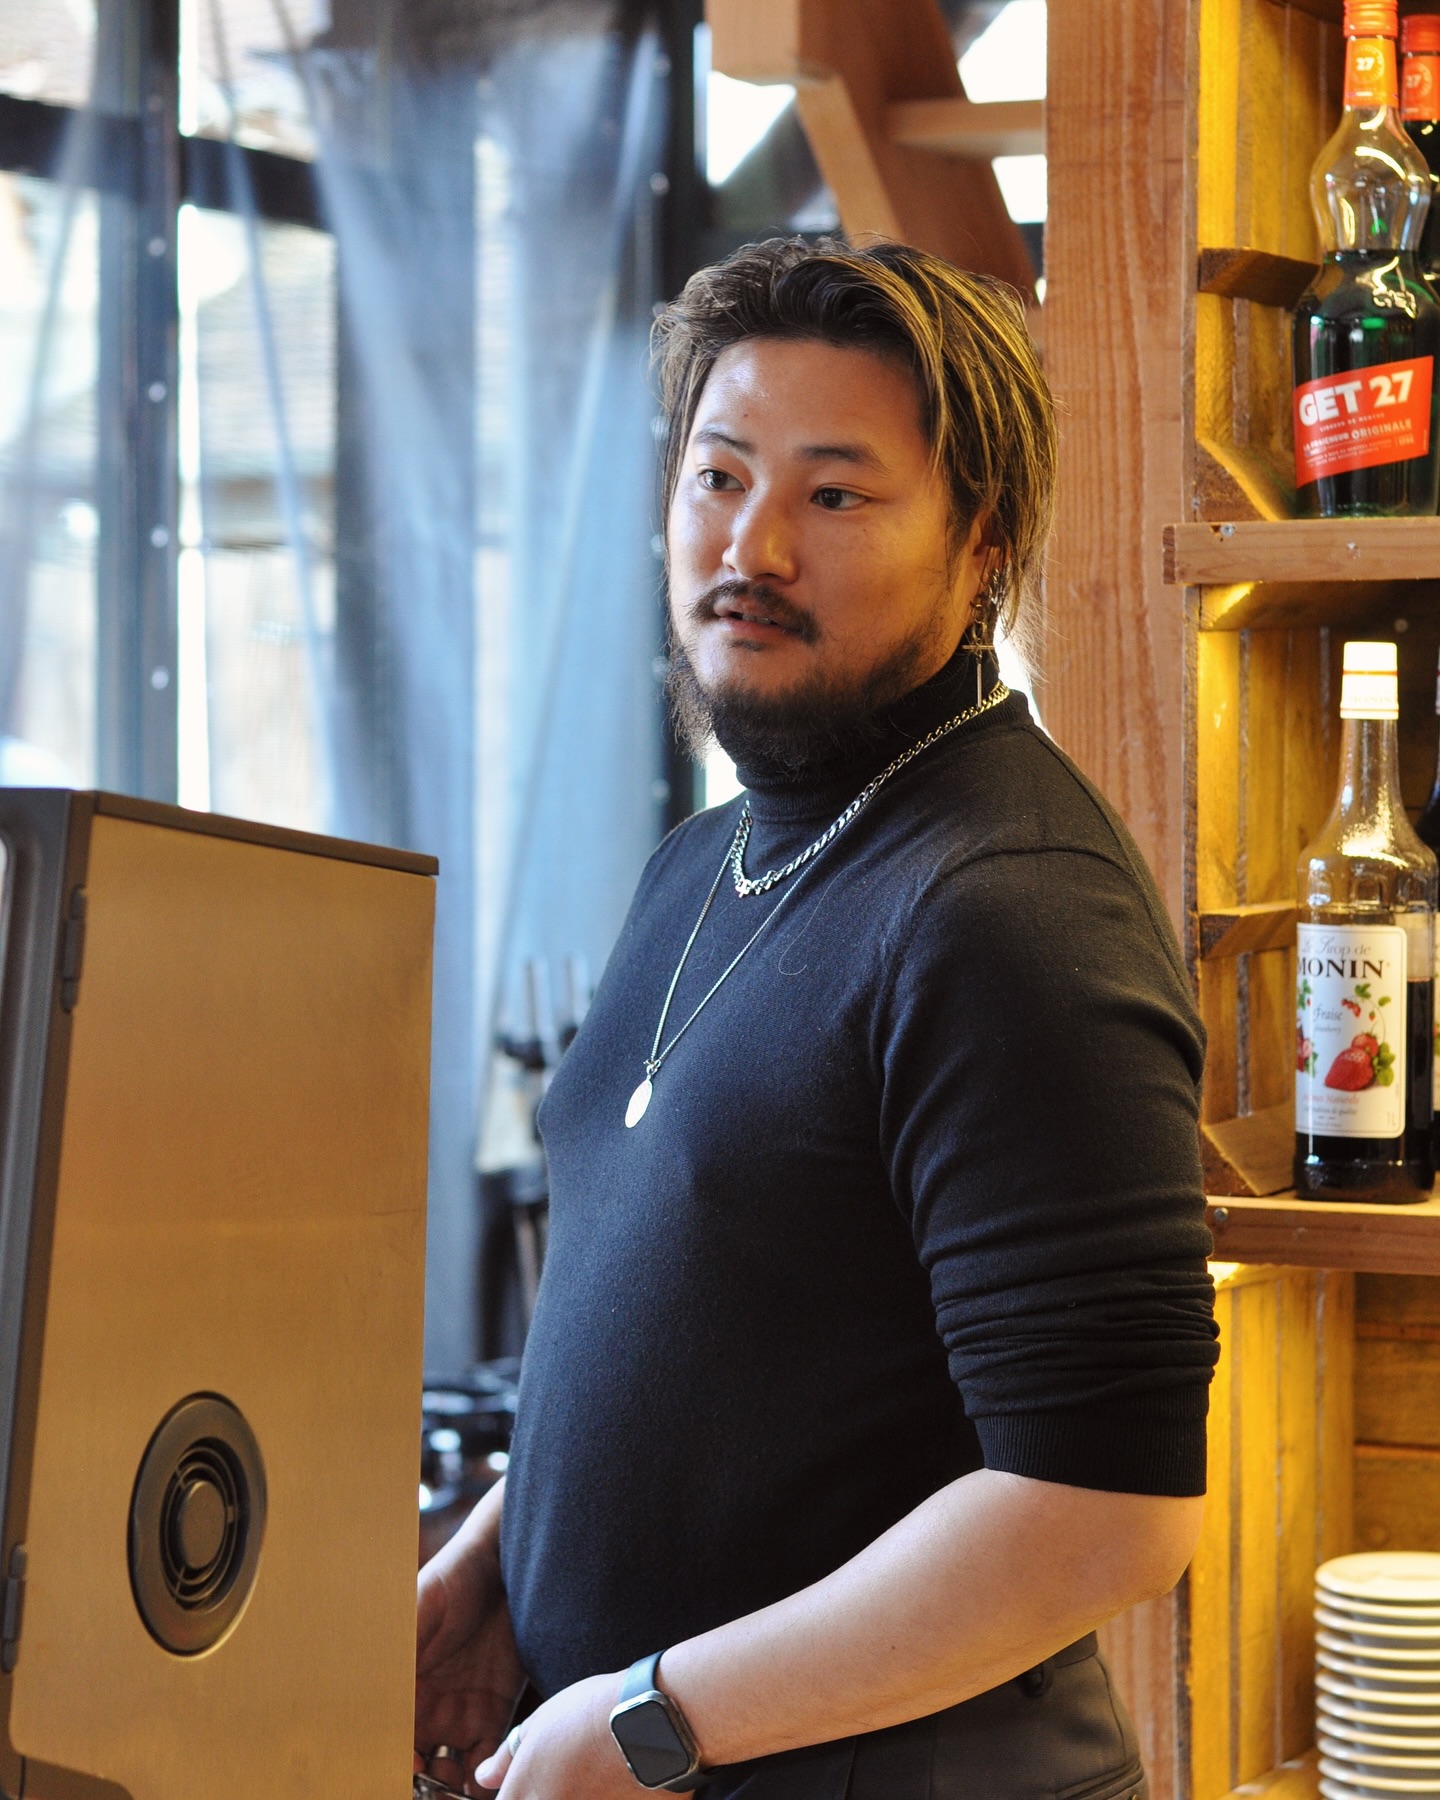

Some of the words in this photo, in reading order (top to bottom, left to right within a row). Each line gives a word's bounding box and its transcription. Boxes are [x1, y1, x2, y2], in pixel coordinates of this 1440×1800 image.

[1356, 57, 1375, 71] 27
[1299, 381, 1362, 426] GET
[1369, 370, 1414, 408] 27
[1351, 418, 1412, 441] ORIGINALE
